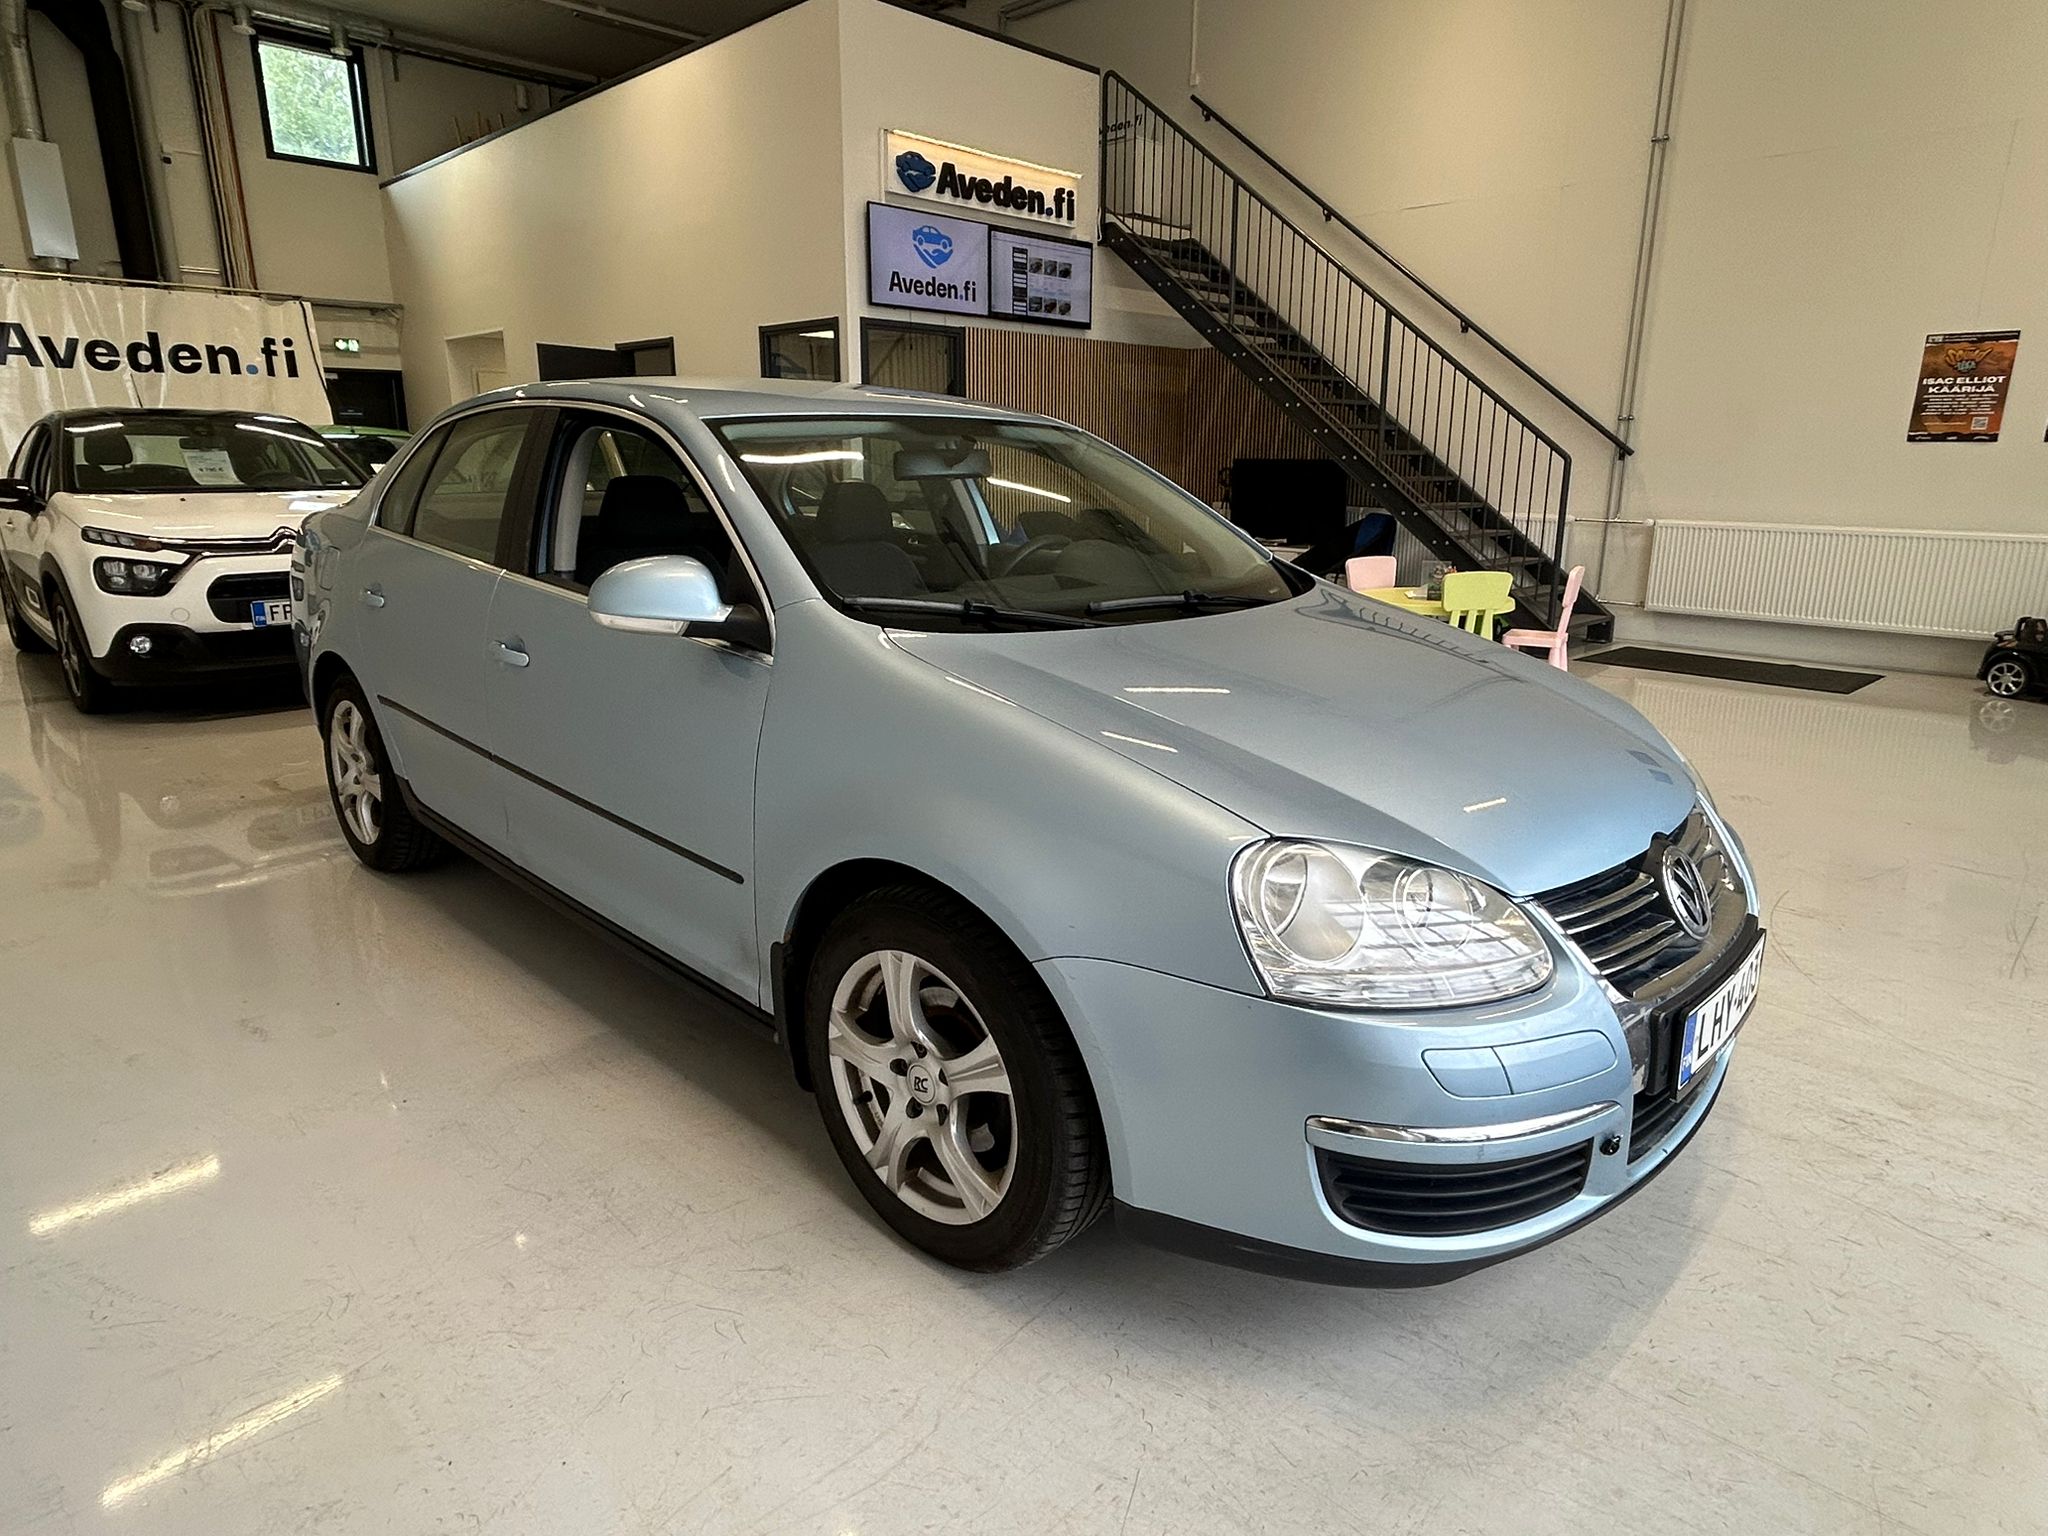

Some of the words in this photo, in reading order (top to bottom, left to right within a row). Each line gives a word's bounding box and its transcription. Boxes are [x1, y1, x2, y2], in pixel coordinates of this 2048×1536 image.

[936, 162, 1075, 221] Aveden.fi
[889, 271, 977, 302] Aveden.fi
[0, 321, 299, 378] Aveden.fi
[1922, 377, 1955, 385] ISAC
[1956, 375, 2007, 384] ELLIOT
[914, 1076, 928, 1093] RC
